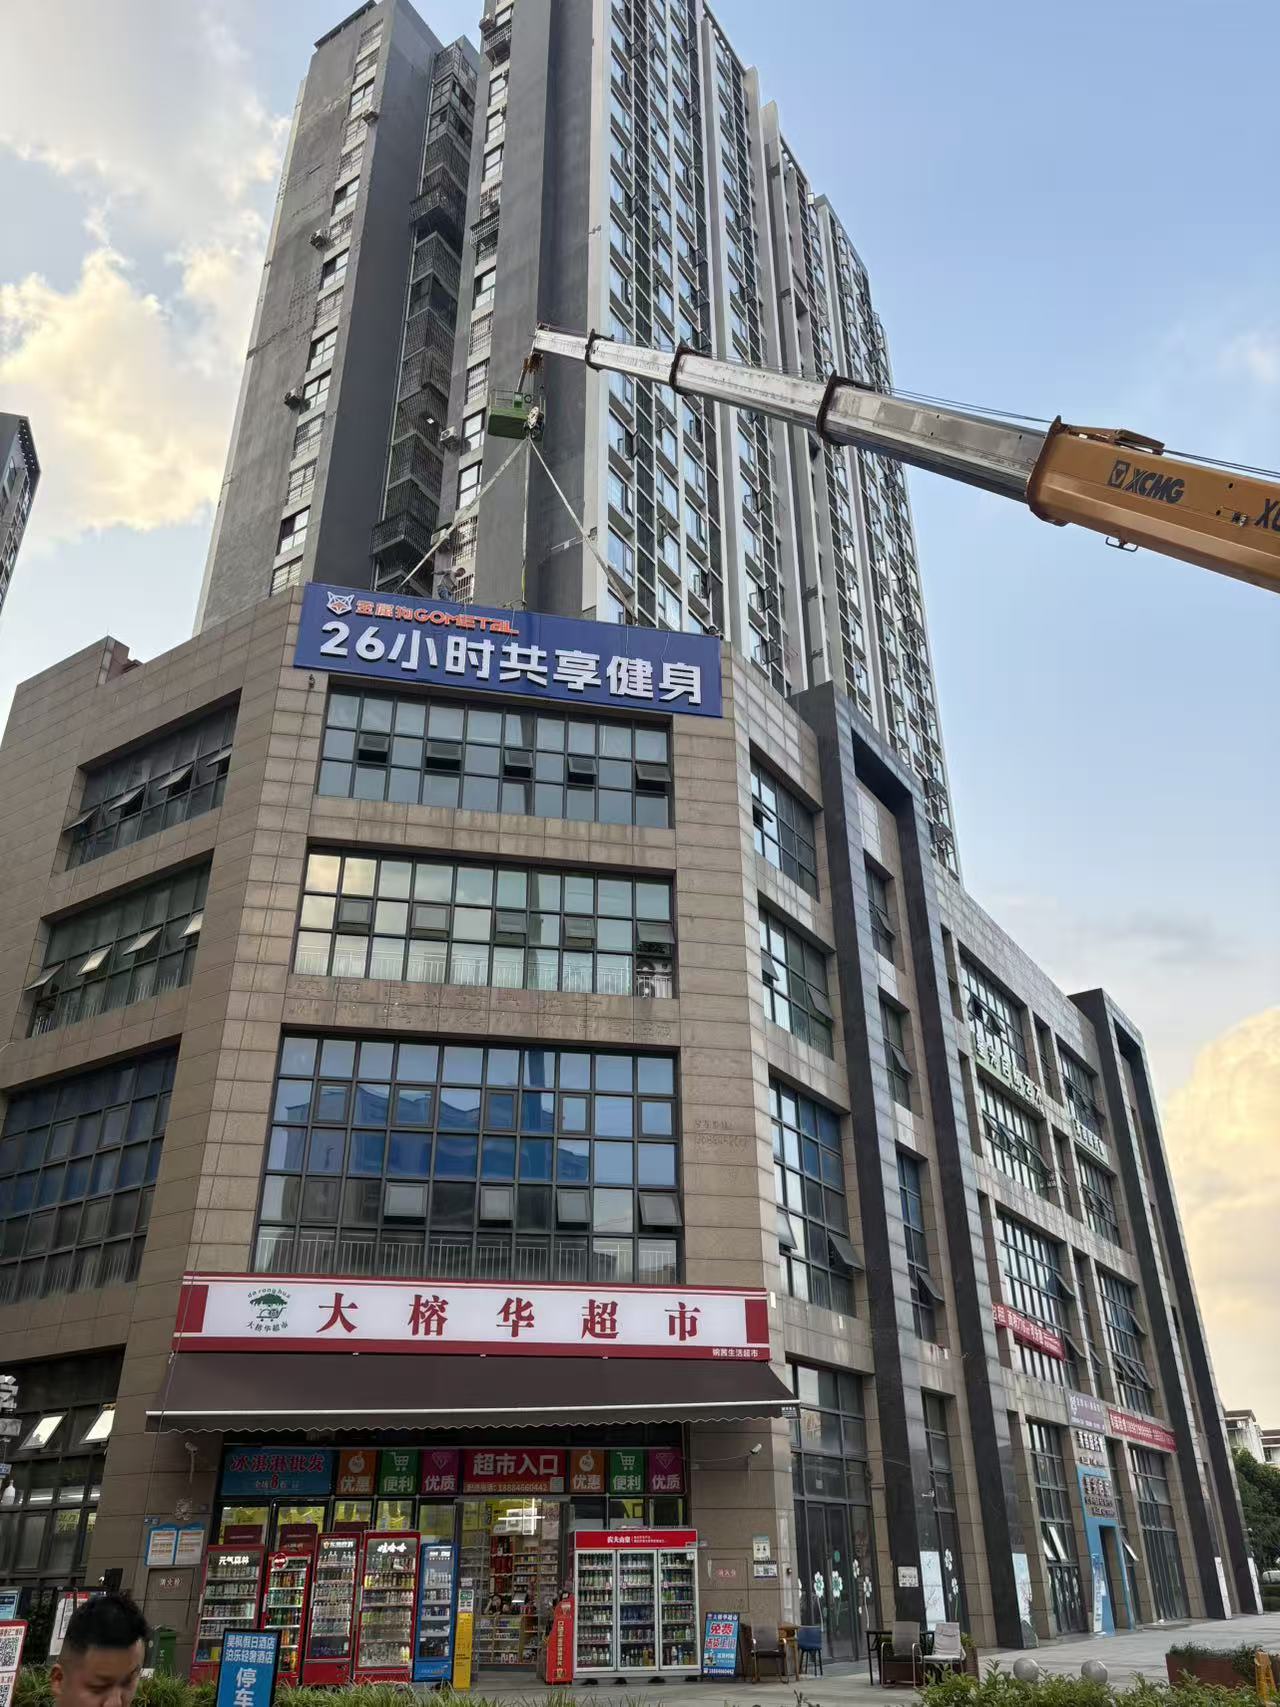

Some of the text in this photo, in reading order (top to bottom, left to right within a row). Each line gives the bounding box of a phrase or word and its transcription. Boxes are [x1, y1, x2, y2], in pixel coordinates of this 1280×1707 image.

[1125, 468, 1185, 503] XCMG
[320, 621, 702, 705] 26小时共享健身
[317, 1292, 702, 1342] 大榕华超市
[473, 1453, 559, 1476] 超市入口
[340, 1476, 370, 1492] 优惠
[383, 1475, 413, 1492] 便利
[424, 1475, 456, 1492] 优质
[573, 1475, 600, 1490] 优惠
[613, 1475, 641, 1490] 便利
[652, 1475, 681, 1490] 优质
[607, 1536, 630, 1544] 农夫山泉
[219, 1556, 249, 1565] 元气森林
[711, 1622, 733, 1635] 免费
[233, 1667, 257, 1707] 停车
